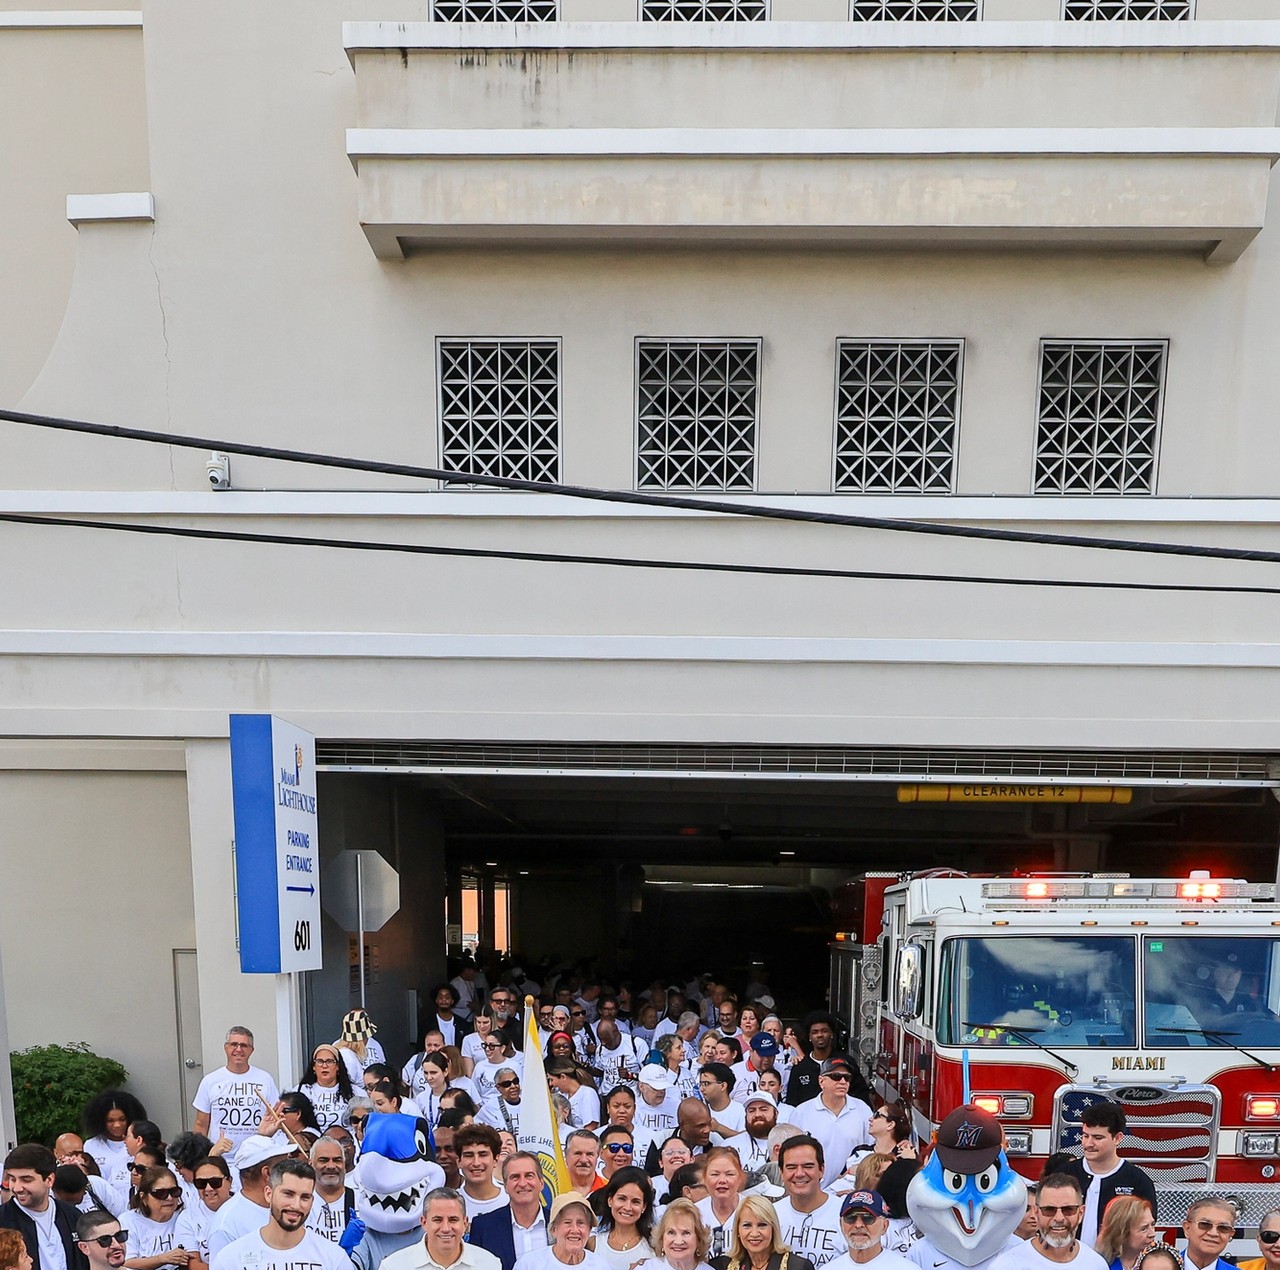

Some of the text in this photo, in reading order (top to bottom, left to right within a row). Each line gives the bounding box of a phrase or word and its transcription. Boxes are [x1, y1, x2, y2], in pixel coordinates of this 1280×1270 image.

[963, 786, 1045, 797] CLEARANCE
[287, 829, 310, 849] PARKING
[286, 854, 312, 873] ENTRANCE
[294, 920, 311, 951] 601
[1111, 1056, 1167, 1071] MIAMI
[218, 1097, 245, 1107] CANE
[219, 1107, 262, 1127] 2026
